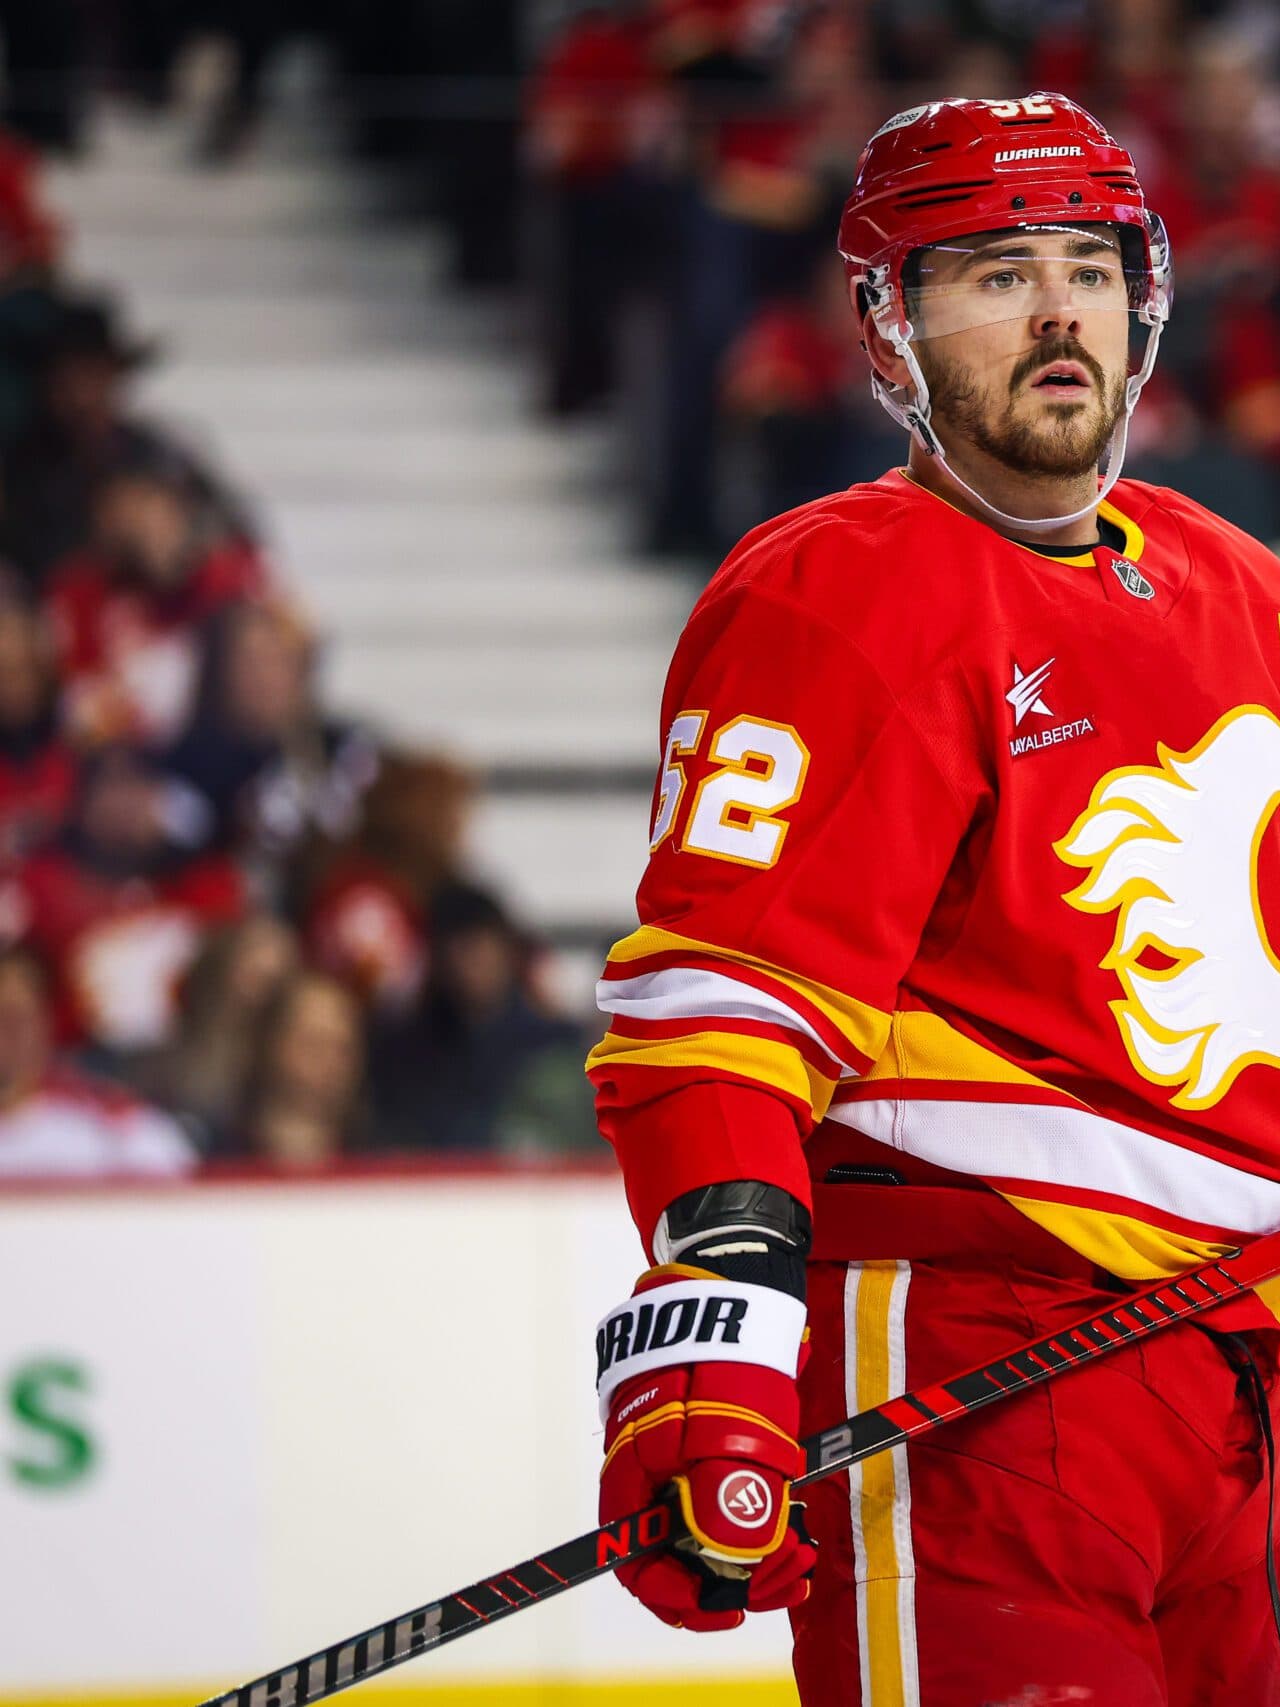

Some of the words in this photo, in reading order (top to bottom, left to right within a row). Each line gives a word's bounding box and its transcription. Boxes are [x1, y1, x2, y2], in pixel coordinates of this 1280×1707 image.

[995, 146, 1082, 163] WARRIOR
[649, 709, 811, 871] 52
[6, 1355, 97, 1492] S
[618, 1388, 659, 1422] COVERT
[220, 1602, 443, 1707] RIOR
